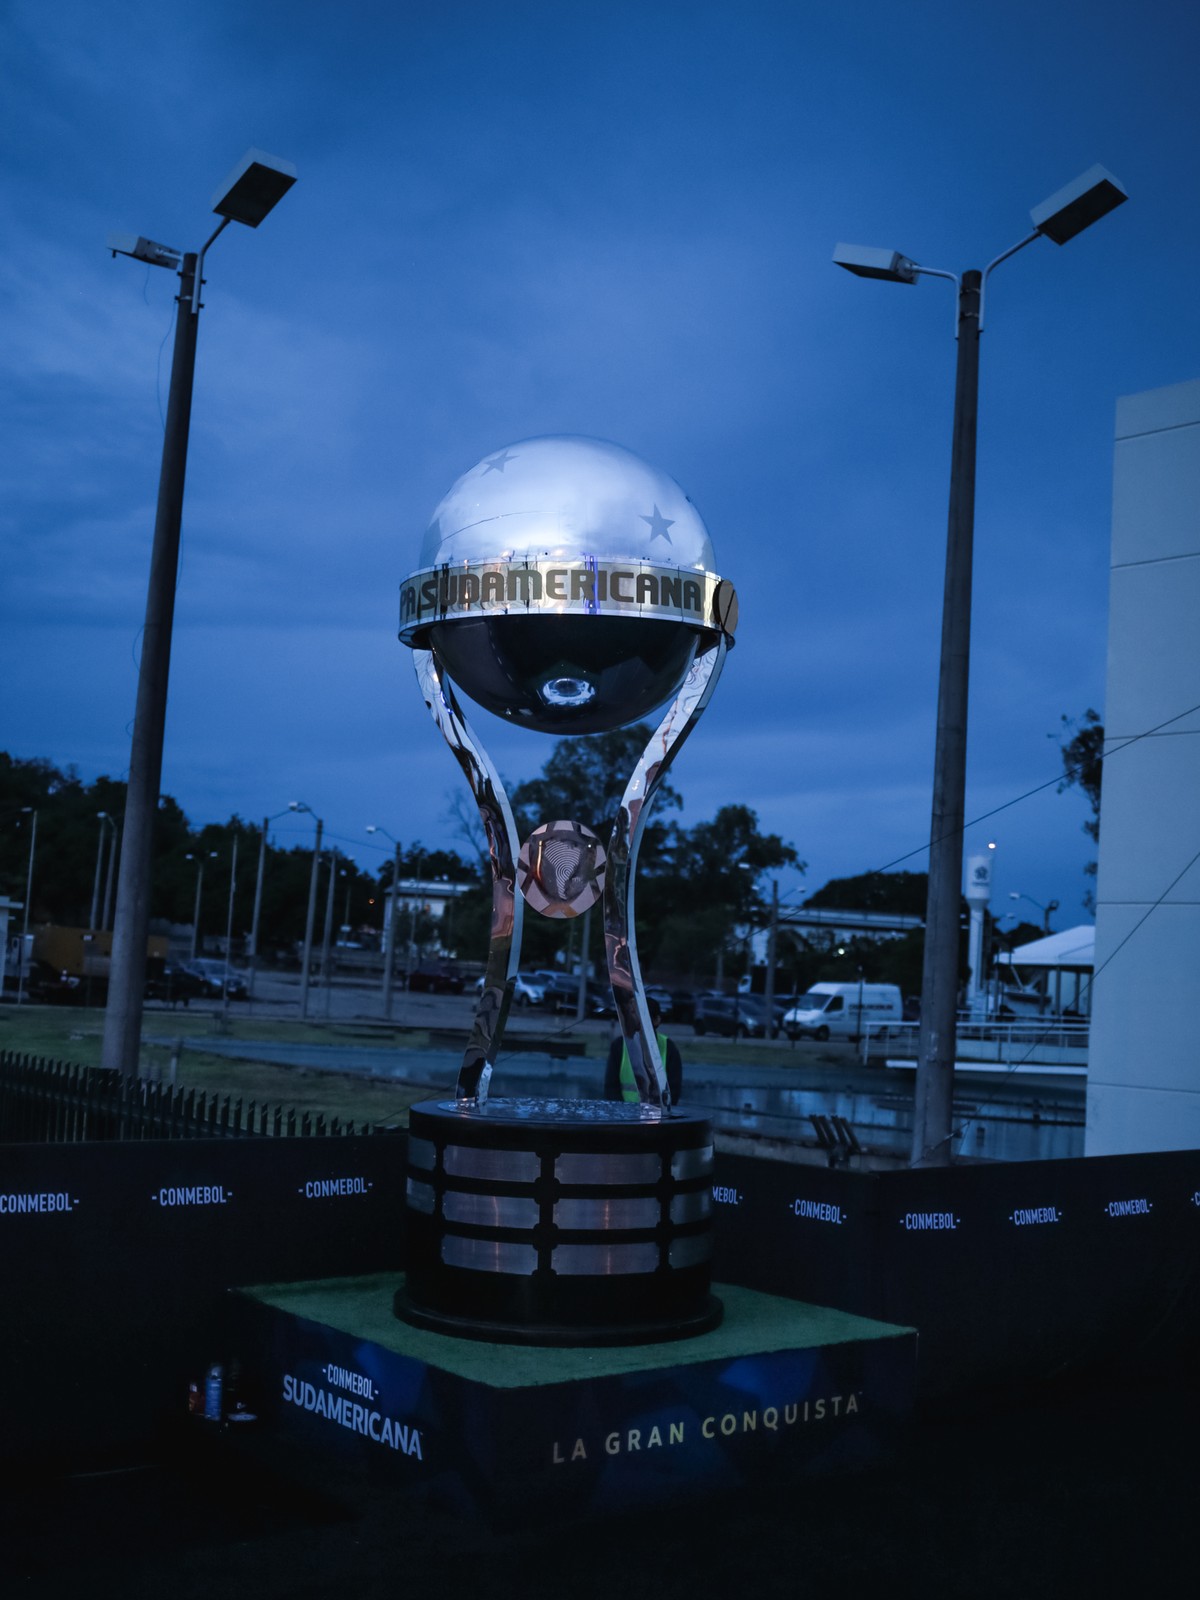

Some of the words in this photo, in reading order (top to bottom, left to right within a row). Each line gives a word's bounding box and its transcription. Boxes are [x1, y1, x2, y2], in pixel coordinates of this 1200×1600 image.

[421, 569, 702, 612] SUDAMERICANA
[282, 1373, 423, 1461] SUDAMERICANA
[552, 1437, 588, 1464] LA
[605, 1421, 685, 1455] GRAN
[701, 1393, 860, 1439] CONQUISTA
